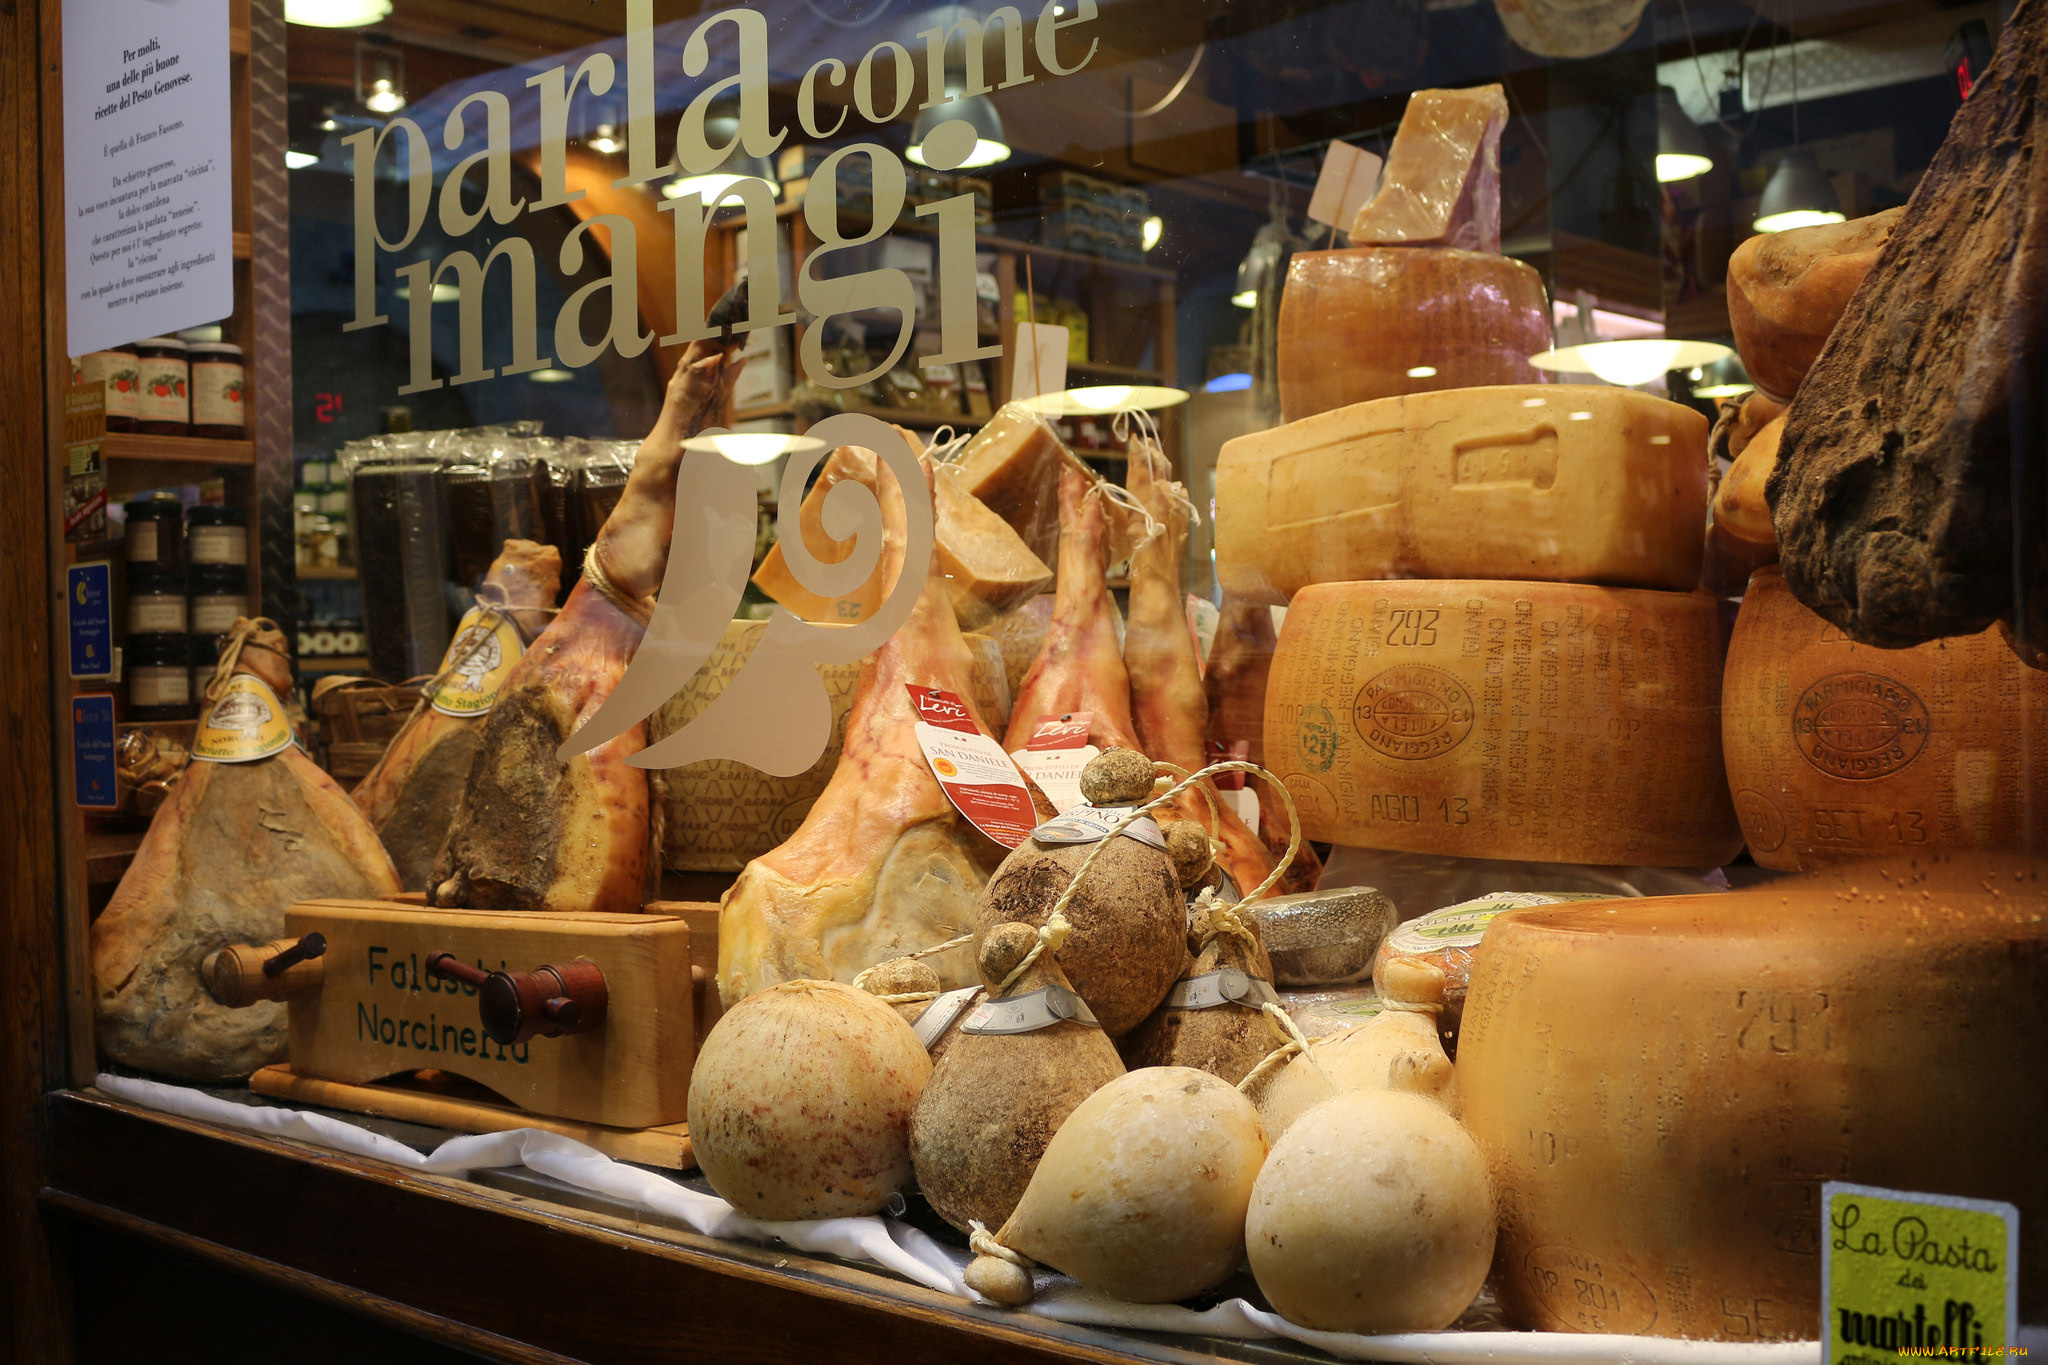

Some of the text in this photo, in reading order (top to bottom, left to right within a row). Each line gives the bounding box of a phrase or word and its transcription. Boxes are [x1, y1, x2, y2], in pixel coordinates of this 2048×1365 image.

[123, 36, 161, 64] Per molti,
[106, 79, 121, 93] una
[122, 68, 140, 87] delle
[155, 54, 180, 73] buone
[94, 73, 193, 121] ricette del Pesto Genovese.
[128, 135, 135, 148] di
[136, 130, 158, 145] Franco
[342, 0, 1101, 333] parla come
[150, 180, 156, 191] la
[118, 209, 125, 220] la
[137, 220, 144, 231] la
[128, 258, 134, 268] la
[396, 120, 1004, 394] mangi
[1385, 609, 1439, 649] 293
[1366, 672, 1461, 703] PARMIGIANO
[919, 694, 967, 717] Levi
[1356, 706, 1372, 721] 13
[1033, 720, 1087, 738] Levi
[1369, 729, 1453, 754] REGGIANO
[930, 746, 1010, 769] SAN DANIELE
[1371, 793, 1420, 823] AGO
[1438, 796, 1469, 826] 13
[1813, 808, 1867, 840] SET
[1888, 810, 1928, 844] 13
[1832, 1204, 1998, 1273] La Pasta
[1837, 1298, 1990, 1364] martelli
